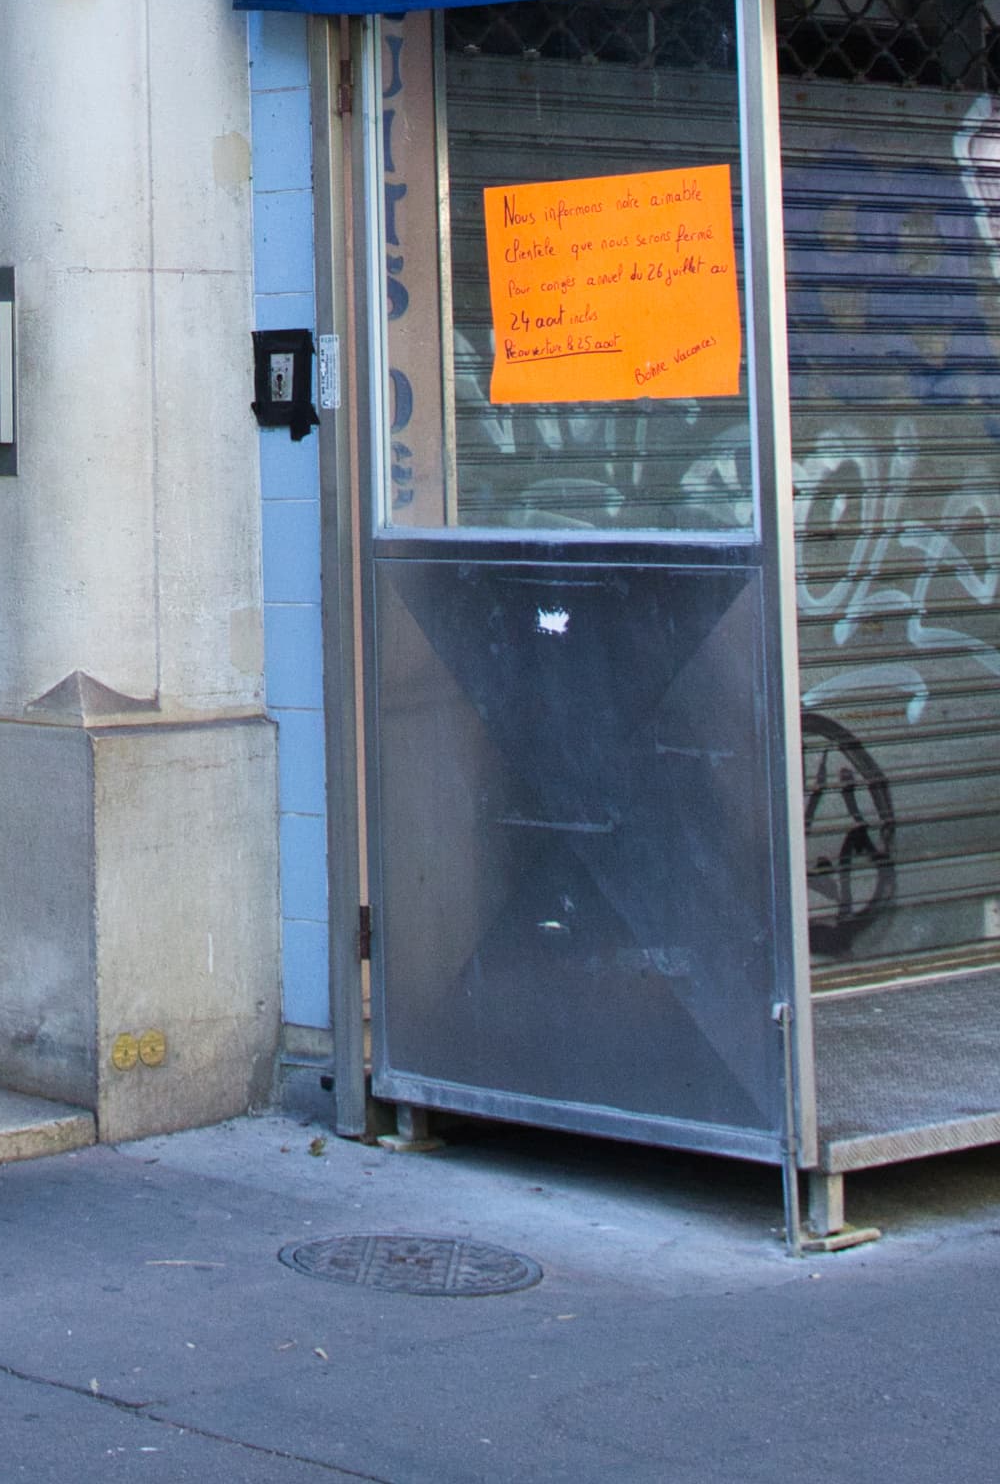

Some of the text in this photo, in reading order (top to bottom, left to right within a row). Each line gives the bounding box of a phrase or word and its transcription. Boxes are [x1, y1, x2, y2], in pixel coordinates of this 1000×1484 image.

[504, 180, 703, 230] Nous informons notre aimable
[571, 241, 593, 260] que
[600, 237, 629, 251] nous
[636, 231, 671, 247] serons
[587, 263, 623, 286] annuel
[630, 262, 643, 282] du
[647, 262, 664, 281] 26
[665, 255, 706, 287] juillet
[711, 264, 728, 275] au
[510, 310, 529, 332] 24
[570, 304, 598, 324] inclus
[577, 336, 592, 350] 25
